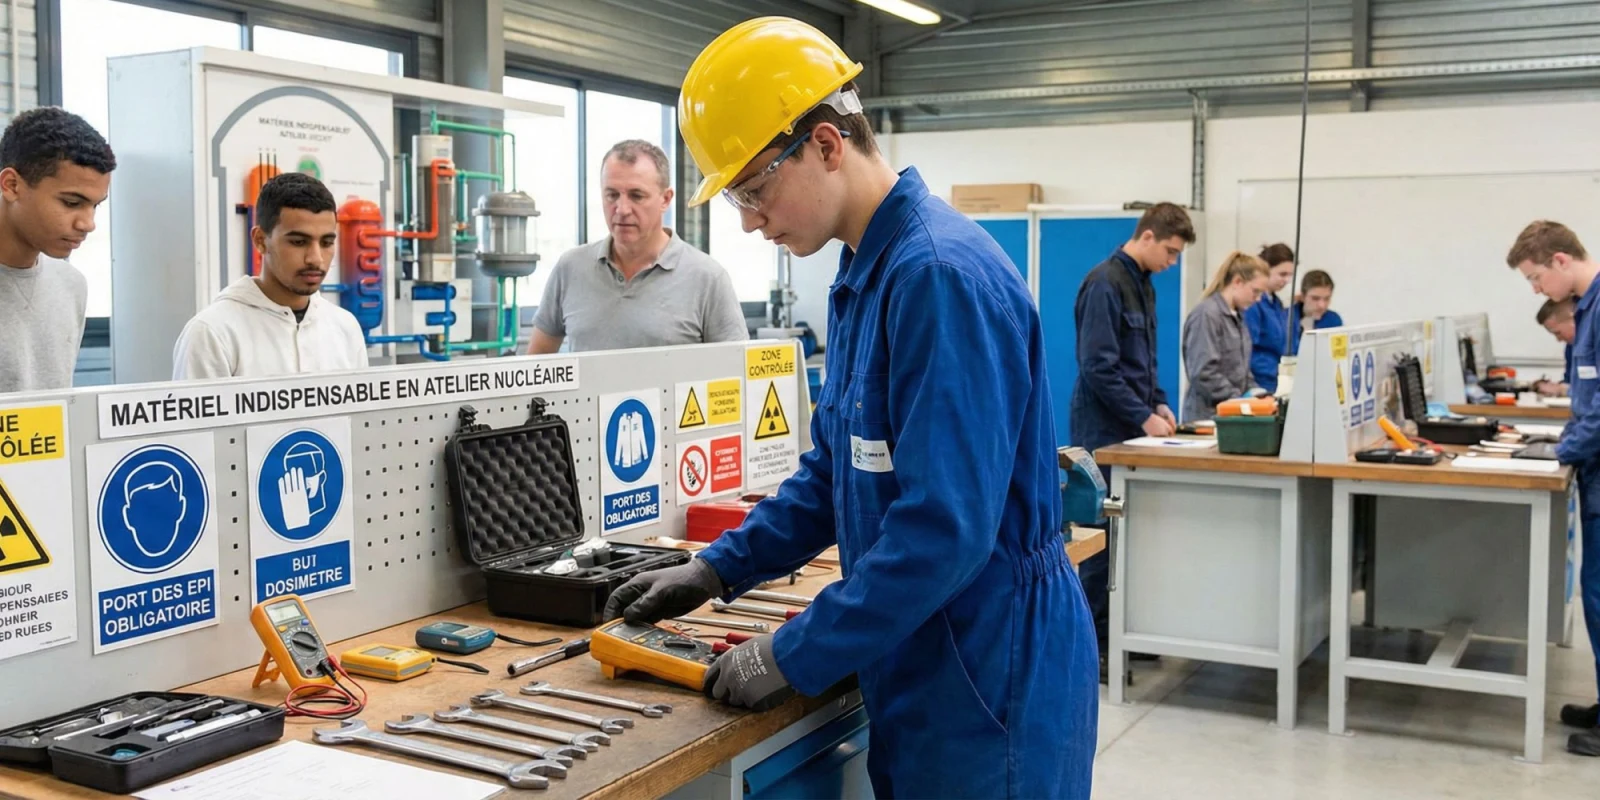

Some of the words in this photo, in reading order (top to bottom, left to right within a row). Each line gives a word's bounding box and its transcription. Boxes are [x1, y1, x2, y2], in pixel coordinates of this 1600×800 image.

[761, 349, 781, 361] ZONE
[749, 360, 794, 377] CONTRÔLÉE
[111, 393, 229, 427] MATÉRIEL
[235, 381, 391, 415] INDISPENSABLE
[396, 378, 419, 399] EN
[424, 373, 490, 396] ATELIER
[494, 364, 574, 389] NUCLÉAIRE
[0, 414, 19, 433] E
[612, 494, 634, 510] PORT
[635, 491, 651, 504] DES
[606, 502, 658, 525] OBLIGATOIRE
[265, 566, 343, 598] DOSIMETRE
[102, 590, 148, 615] PORT
[152, 583, 184, 604] DES
[187, 576, 212, 596] EPI
[105, 598, 211, 636] OBLIGATOIRE
[15, 621, 53, 639] RUEES
